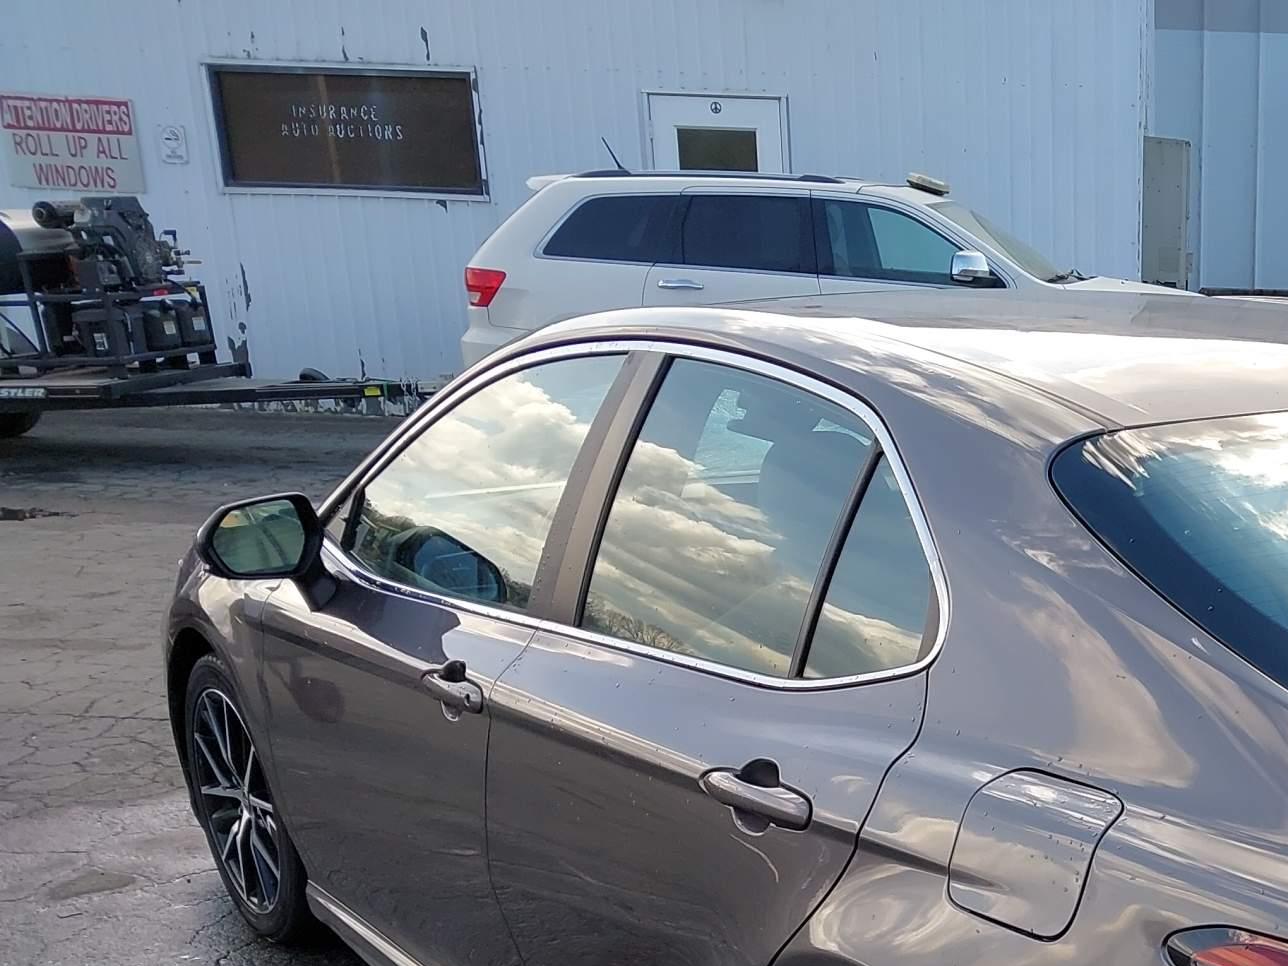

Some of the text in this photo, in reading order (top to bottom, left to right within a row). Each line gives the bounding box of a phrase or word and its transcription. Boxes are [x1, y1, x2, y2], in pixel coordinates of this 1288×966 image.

[3, 99, 130, 132] ATTENTION DRIVERS
[291, 104, 379, 121] INSURANCE
[12, 132, 129, 160] ROLL UP ALL
[33, 162, 117, 189] WINDOWS
